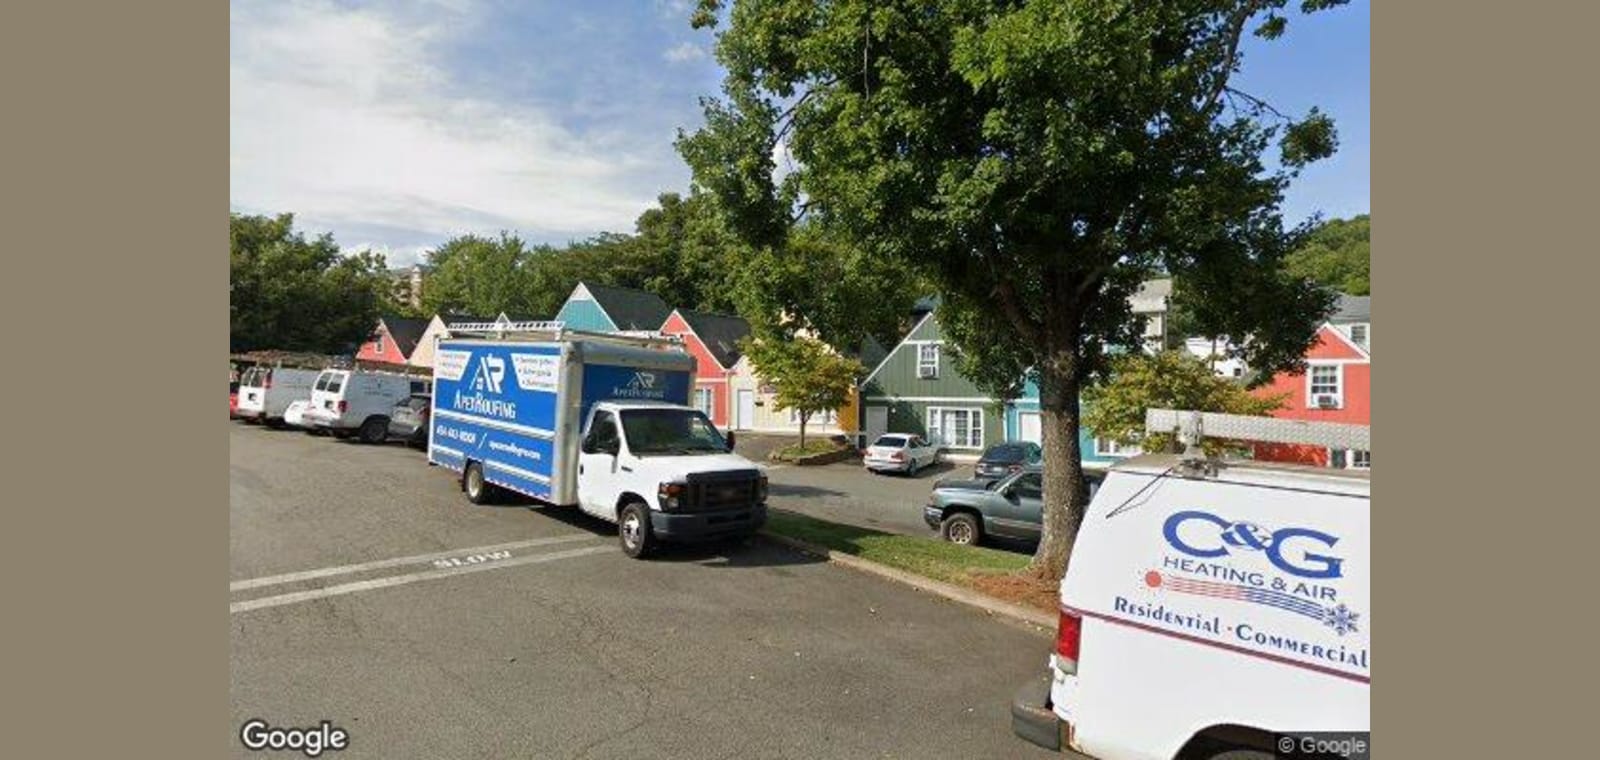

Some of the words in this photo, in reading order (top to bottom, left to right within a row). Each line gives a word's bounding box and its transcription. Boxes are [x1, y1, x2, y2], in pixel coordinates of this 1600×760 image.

[433, 550, 512, 567] SLOW
[1162, 510, 1344, 580] C&G
[1163, 556, 1265, 587] HEATING
[1271, 577, 1287, 591] &
[1292, 583, 1337, 602] AIR
